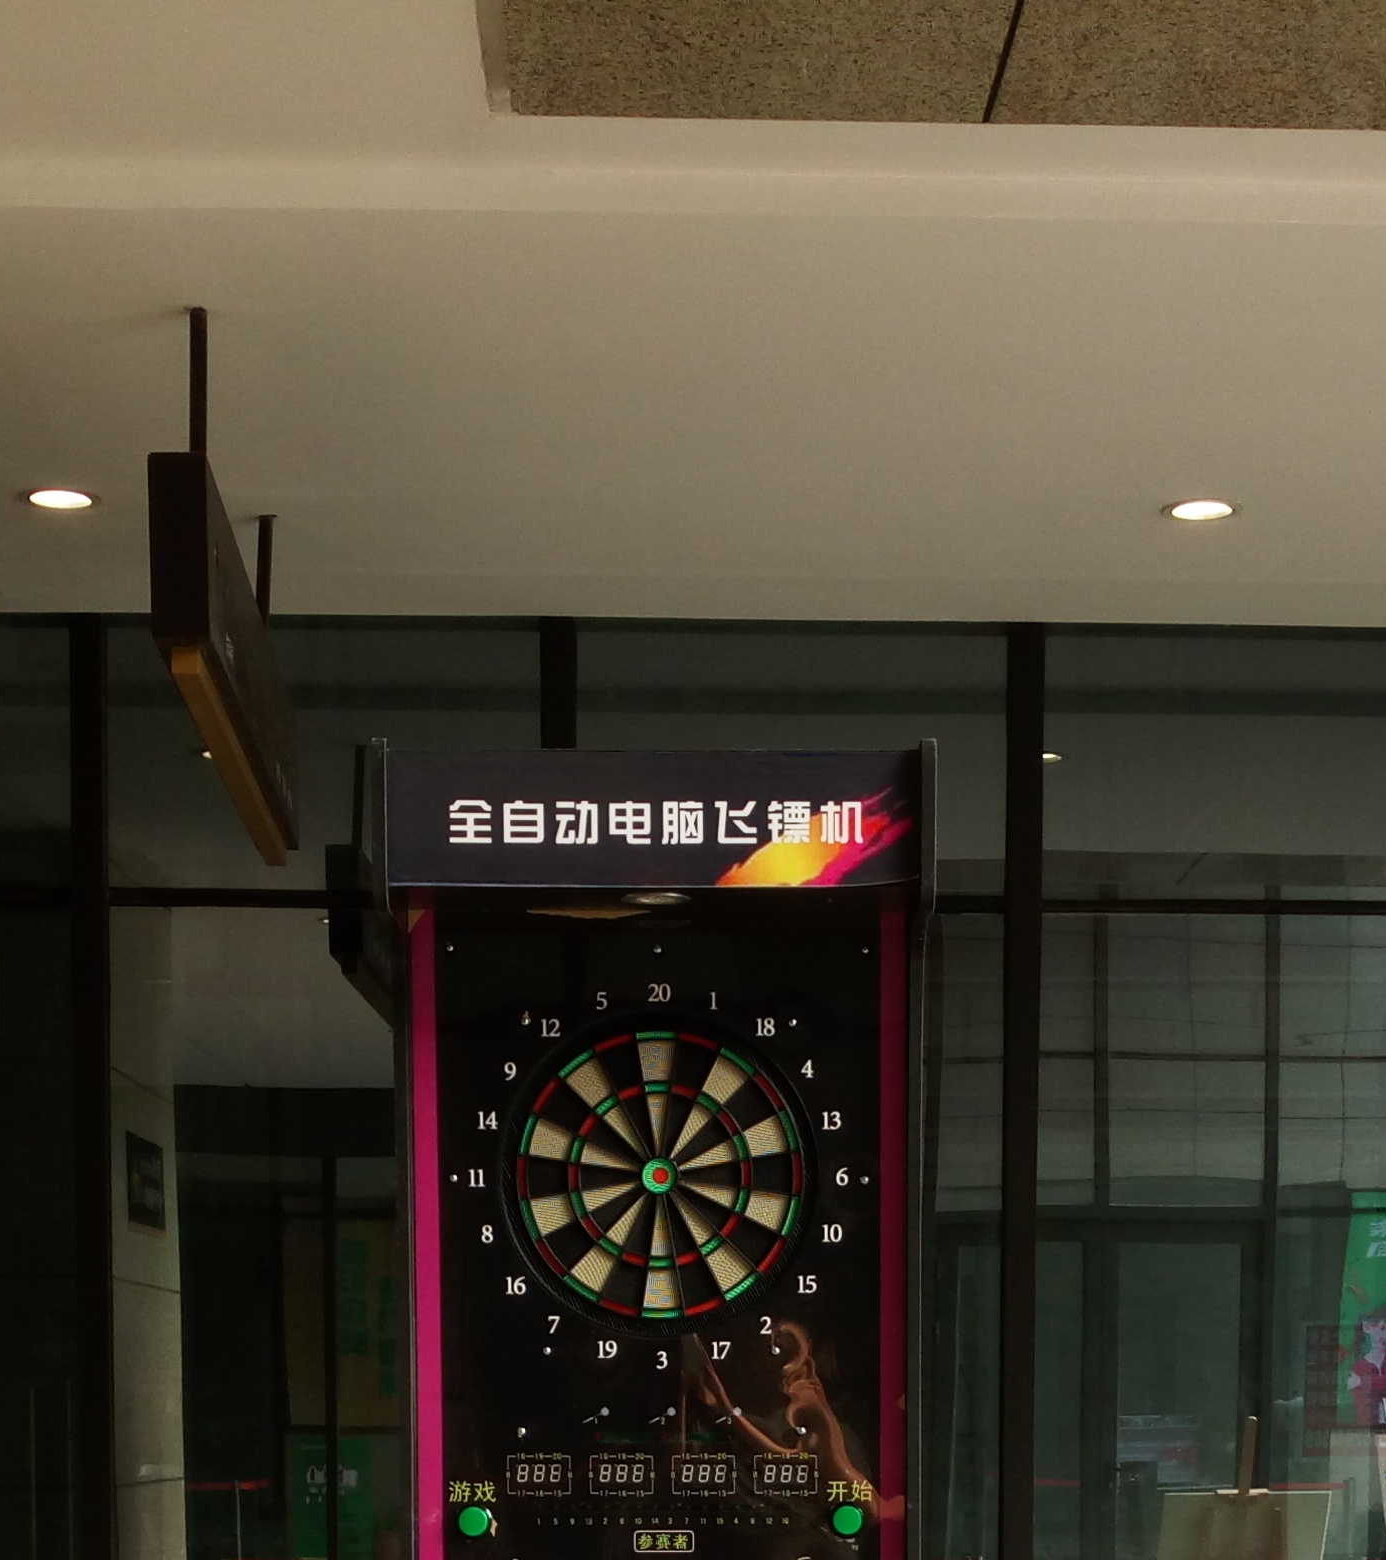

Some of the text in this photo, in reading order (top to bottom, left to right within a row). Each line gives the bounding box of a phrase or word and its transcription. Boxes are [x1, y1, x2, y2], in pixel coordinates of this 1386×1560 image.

[449, 799, 864, 845] 全自动电脑飞镖机
[596, 991, 608, 1010] 5
[648, 983, 671, 1002] 20
[710, 991, 718, 1010] 1
[541, 1018, 561, 1037] 12
[756, 1017, 776, 1037] 18
[504, 1061, 517, 1081] 9
[801, 1059, 814, 1078] 4
[478, 1111, 498, 1130] 14
[822, 1111, 842, 1131] 13
[469, 1168, 485, 1187] 11
[835, 1167, 849, 1186] 6
[481, 1224, 494, 1244] 8
[822, 1223, 843, 1243] 10
[506, 1276, 527, 1295] 16
[797, 1275, 817, 1294] 15
[547, 1315, 560, 1334] 7
[759, 1316, 772, 1335] 2
[597, 1340, 618, 1359] 19
[711, 1341, 731, 1360] 17
[656, 1350, 668, 1370] 3
[449, 1481, 496, 1502] 游戏
[827, 1478, 873, 1501] 开始
